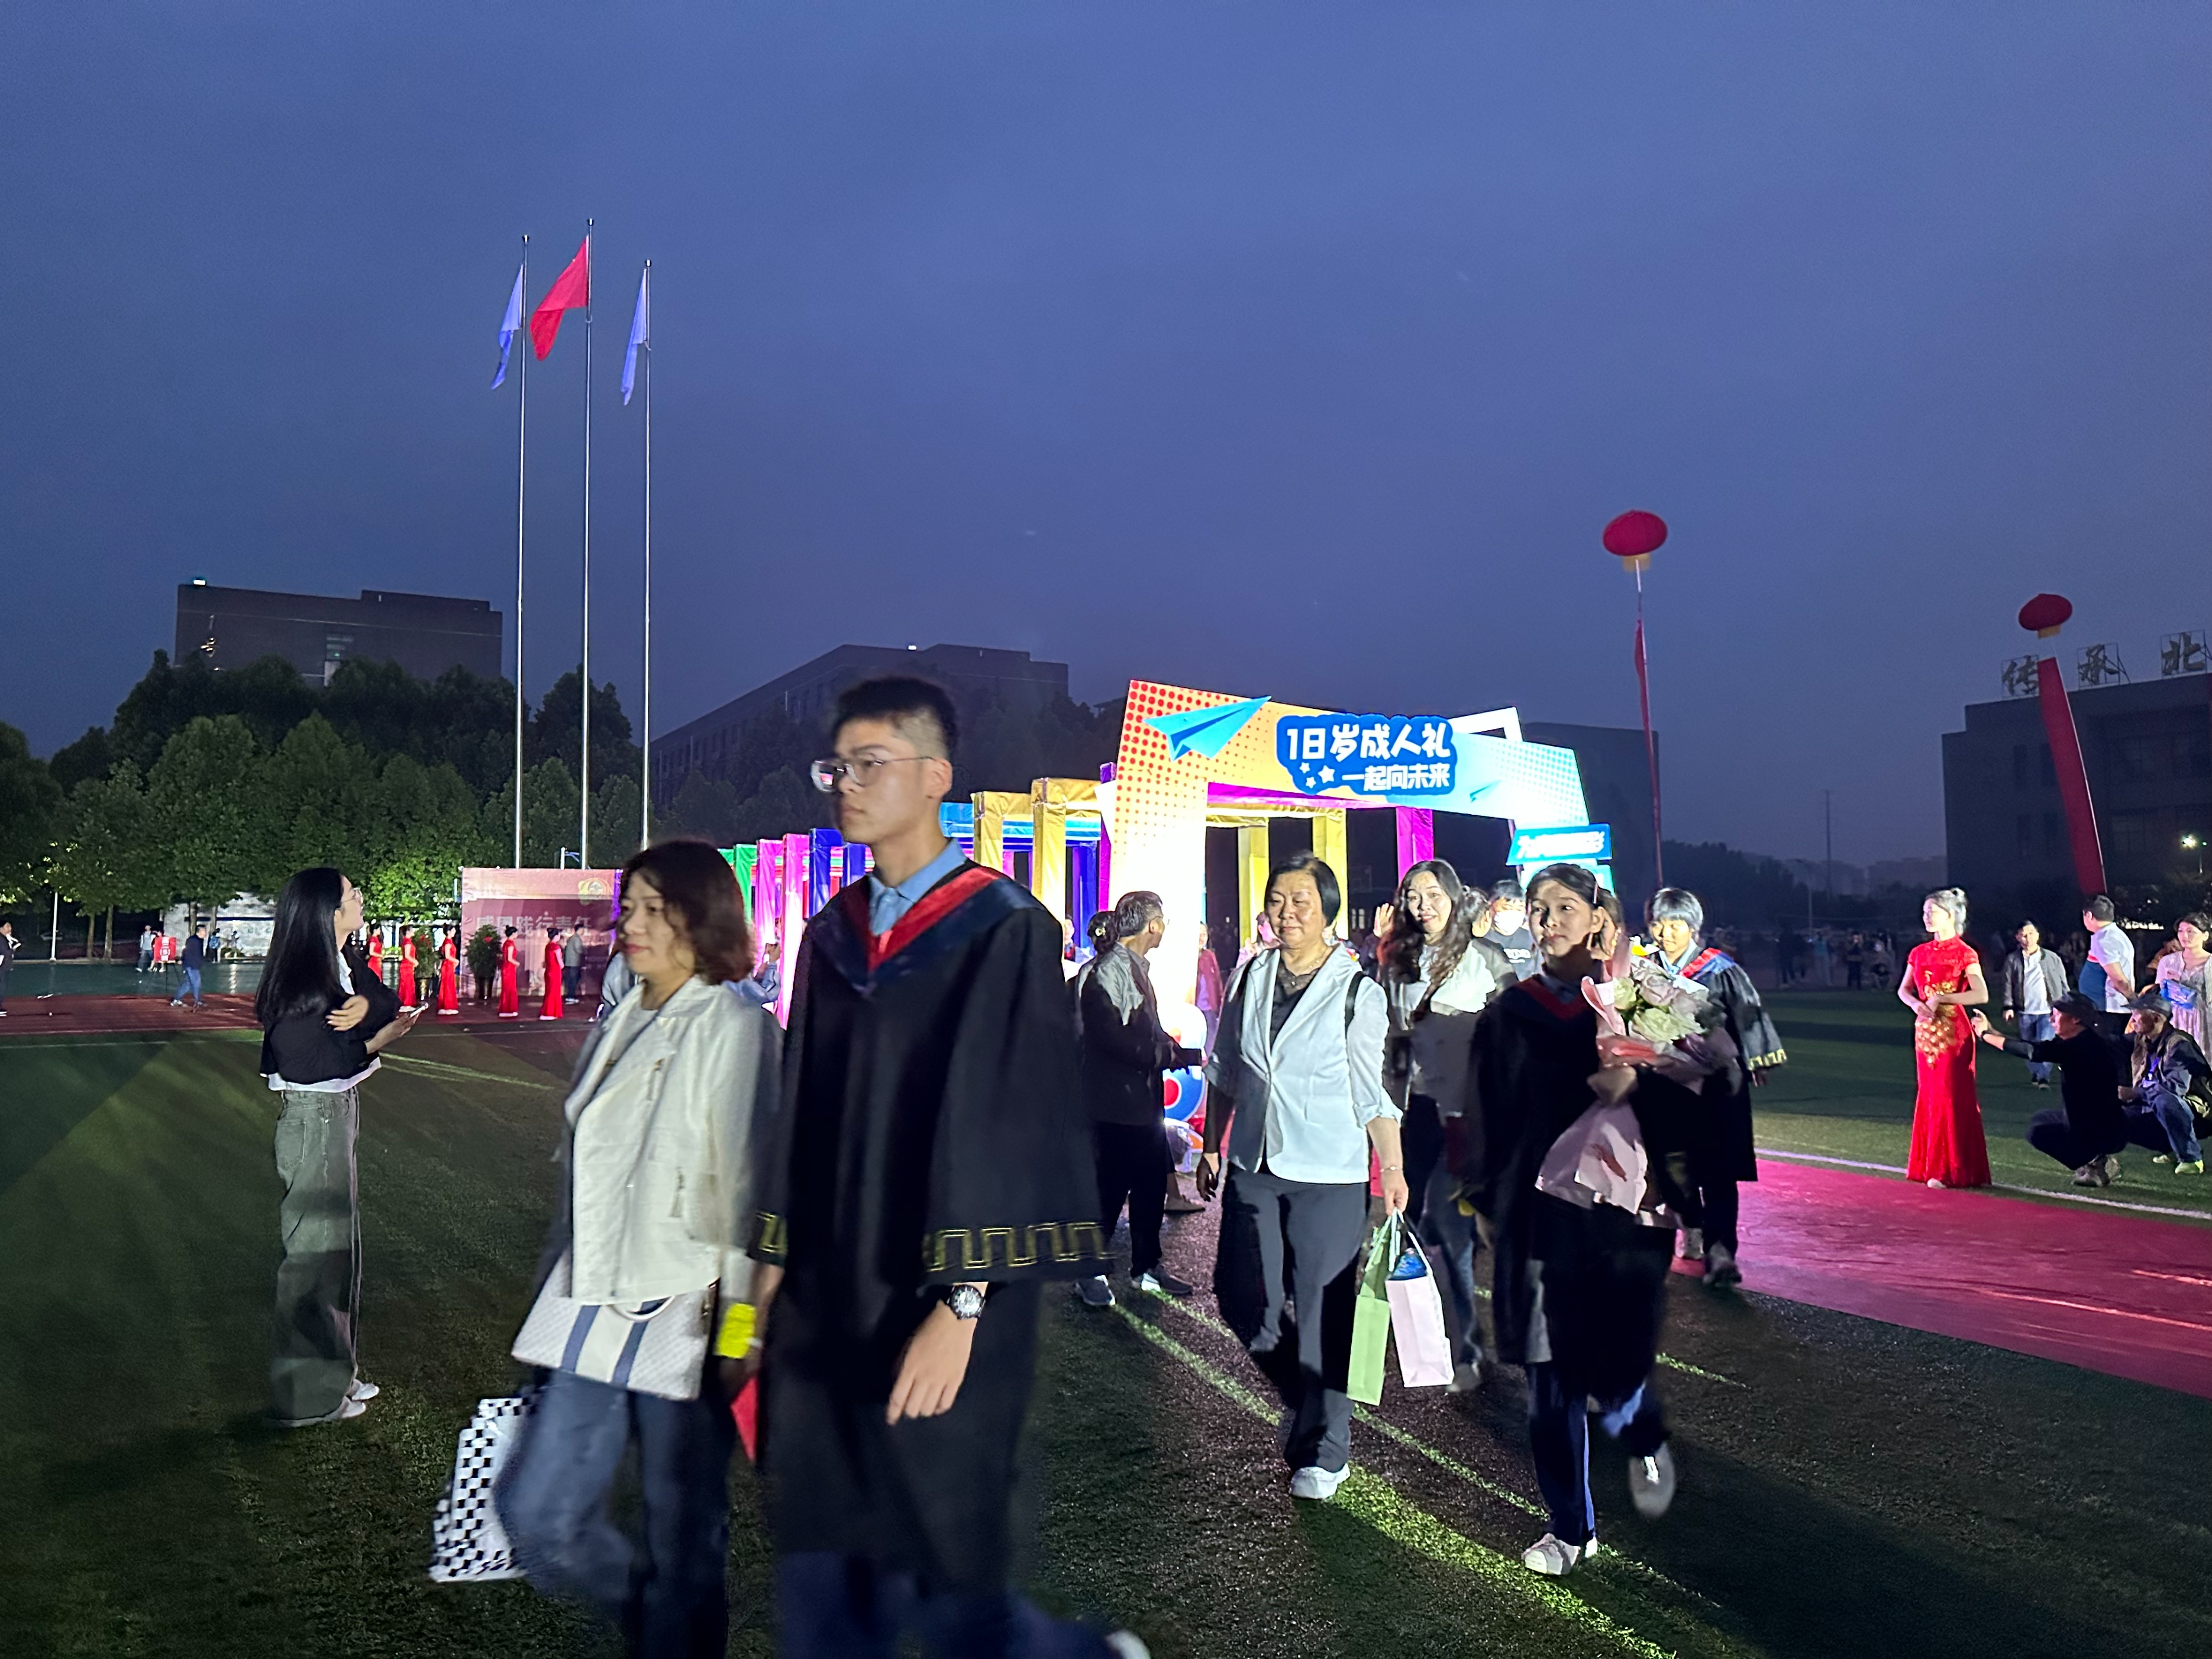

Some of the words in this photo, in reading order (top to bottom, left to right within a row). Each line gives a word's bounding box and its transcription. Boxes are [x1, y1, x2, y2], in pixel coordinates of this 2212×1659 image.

[1342, 763, 1450, 791] 一起向未来
